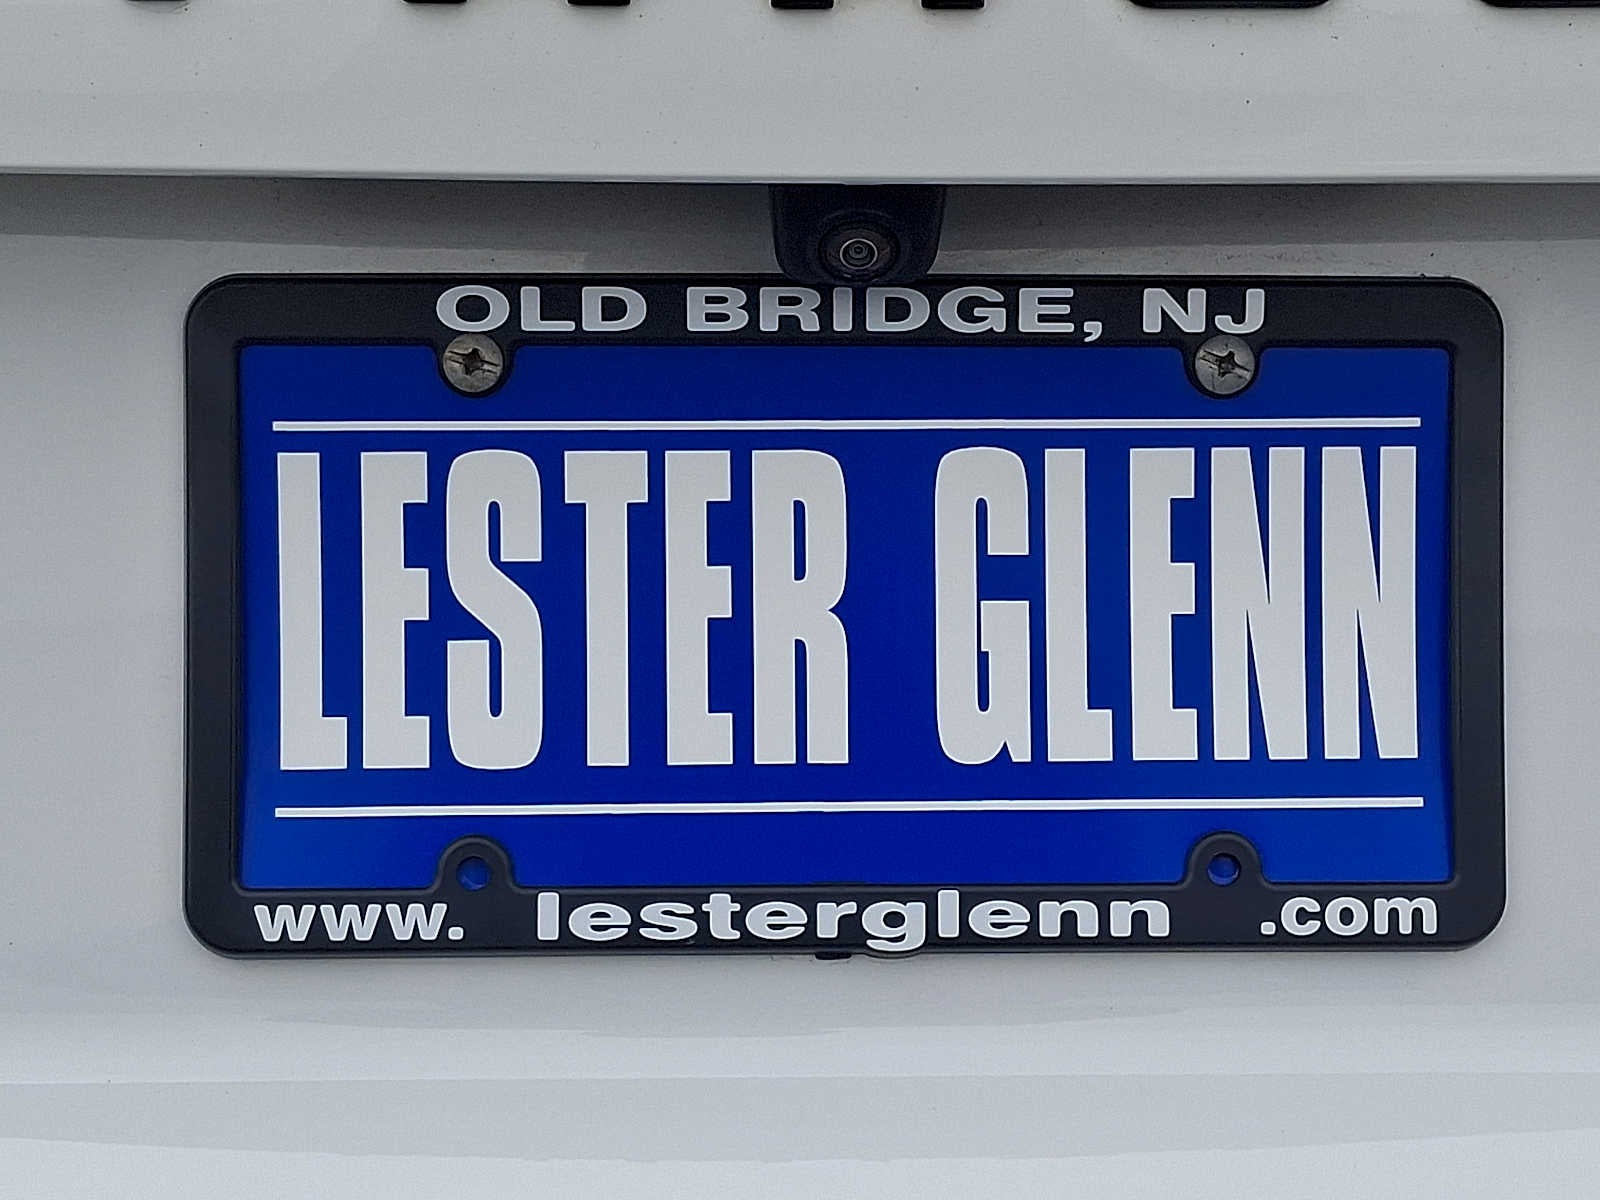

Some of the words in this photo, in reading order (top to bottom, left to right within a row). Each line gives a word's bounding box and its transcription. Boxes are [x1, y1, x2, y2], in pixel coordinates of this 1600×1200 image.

[435, 284, 647, 333] OLD
[686, 286, 1104, 343] BRIDGE,
[1142, 287, 1266, 335] NJ
[276, 449, 849, 771] LESTER
[934, 445, 1419, 765] GLENN
[253, 902, 464, 942] www.
[537, 889, 1170, 952] lesterglenn
[1260, 896, 1438, 937] .com
